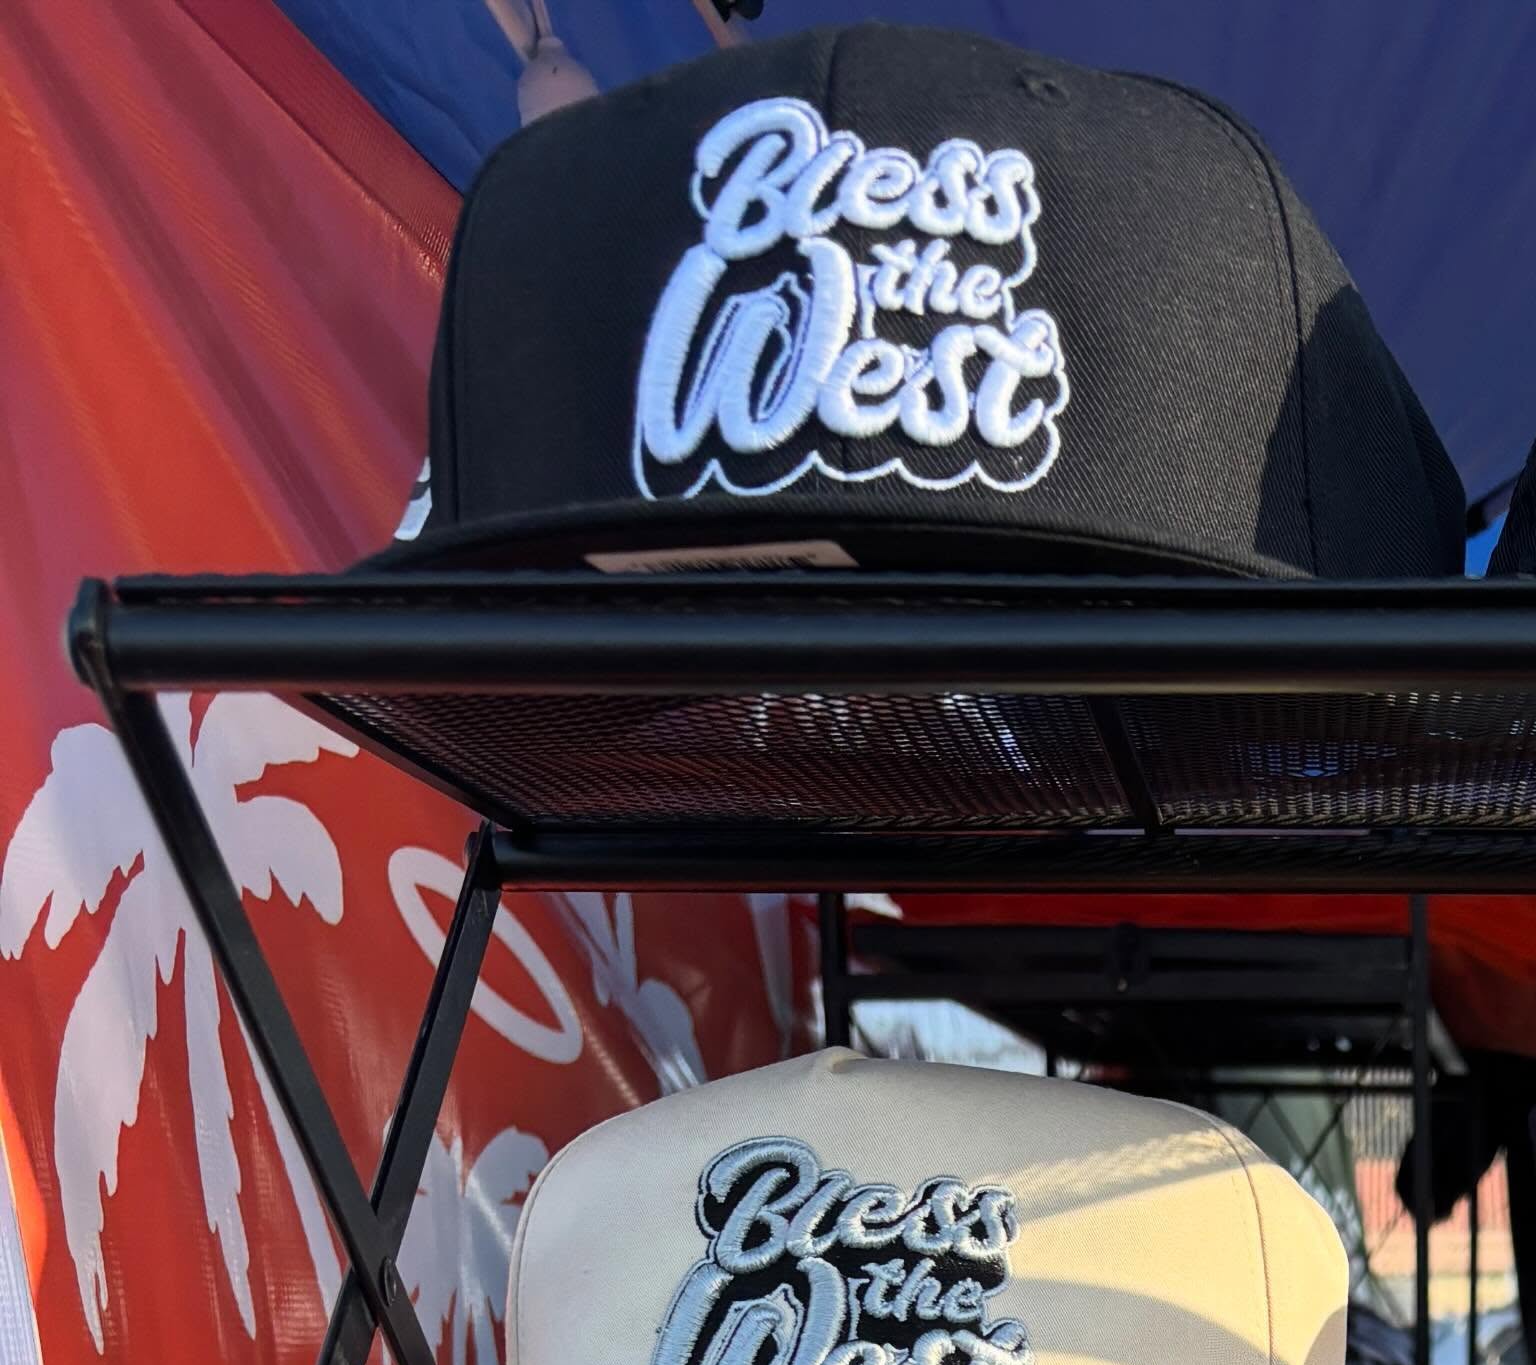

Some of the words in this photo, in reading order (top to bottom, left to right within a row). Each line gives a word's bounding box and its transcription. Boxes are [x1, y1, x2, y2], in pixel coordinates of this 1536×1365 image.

[690, 97, 1039, 260] Bless
[870, 238, 1003, 318] the
[636, 236, 1064, 482] West
[697, 1136, 1018, 1274] Bless
[861, 1257, 985, 1323] the
